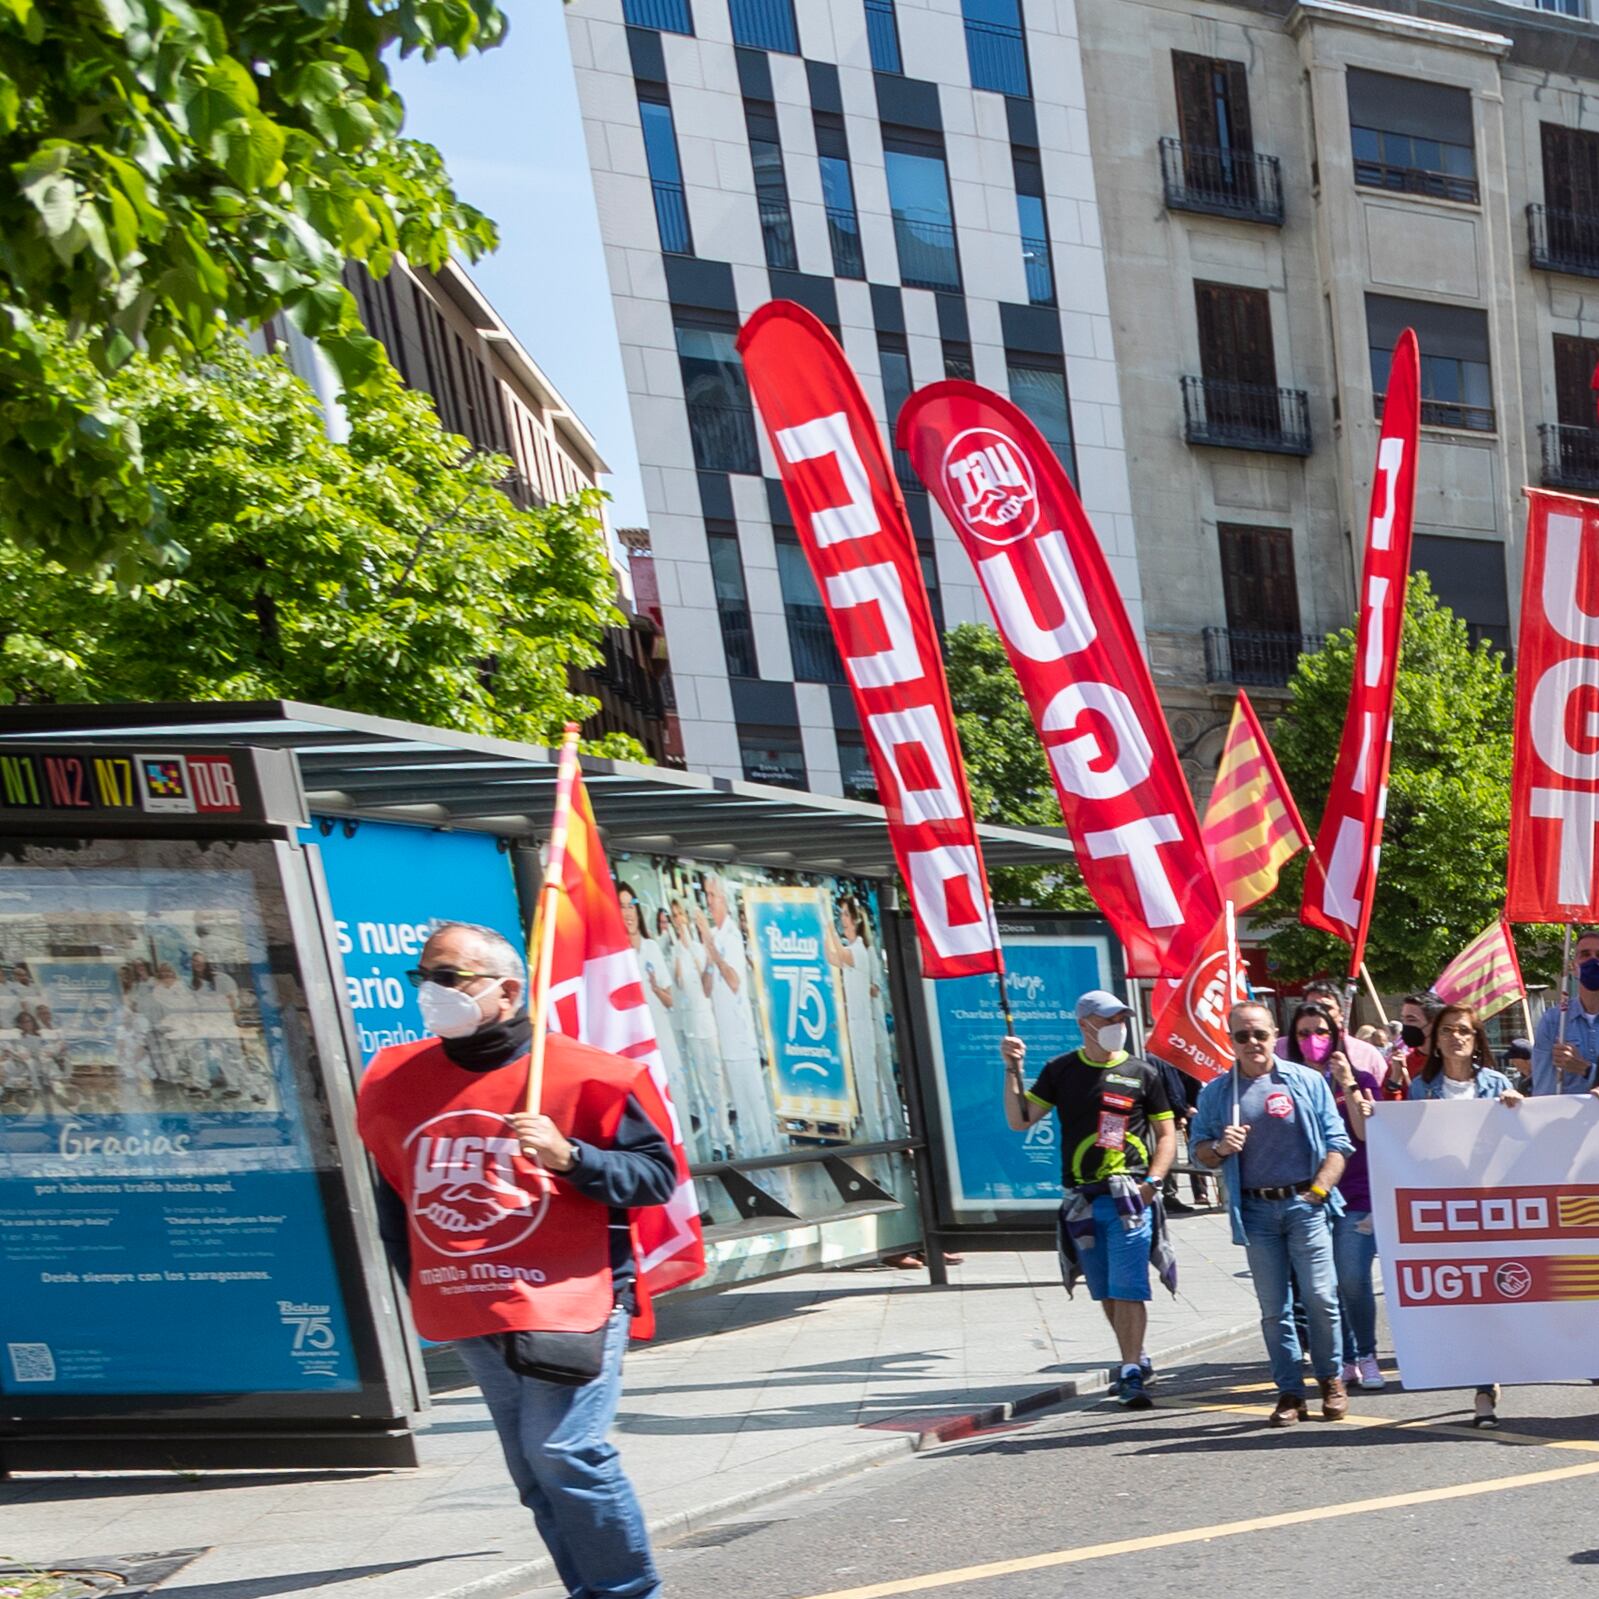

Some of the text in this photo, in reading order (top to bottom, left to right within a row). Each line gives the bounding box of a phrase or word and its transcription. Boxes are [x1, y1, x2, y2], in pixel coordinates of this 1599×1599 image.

[1, 756, 241, 807] N1 N2 N7 TUR
[357, 921, 432, 956] nues
[765, 924, 818, 952] Balay
[772, 965, 827, 1042] 75
[60, 1123, 190, 1161] Gracias
[415, 1136, 523, 1190] UGT
[34, 1184, 58, 1196] por
[165, 1181, 202, 1193] hasta
[1410, 1197, 1549, 1232] CCOO
[41, 1270, 273, 1285] Desde siempre con los zaragozanos.
[470, 1263, 546, 1283] mano
[1403, 1264, 1488, 1300] UGT
[276, 1300, 331, 1314] Balay
[281, 1316, 336, 1350] 75
